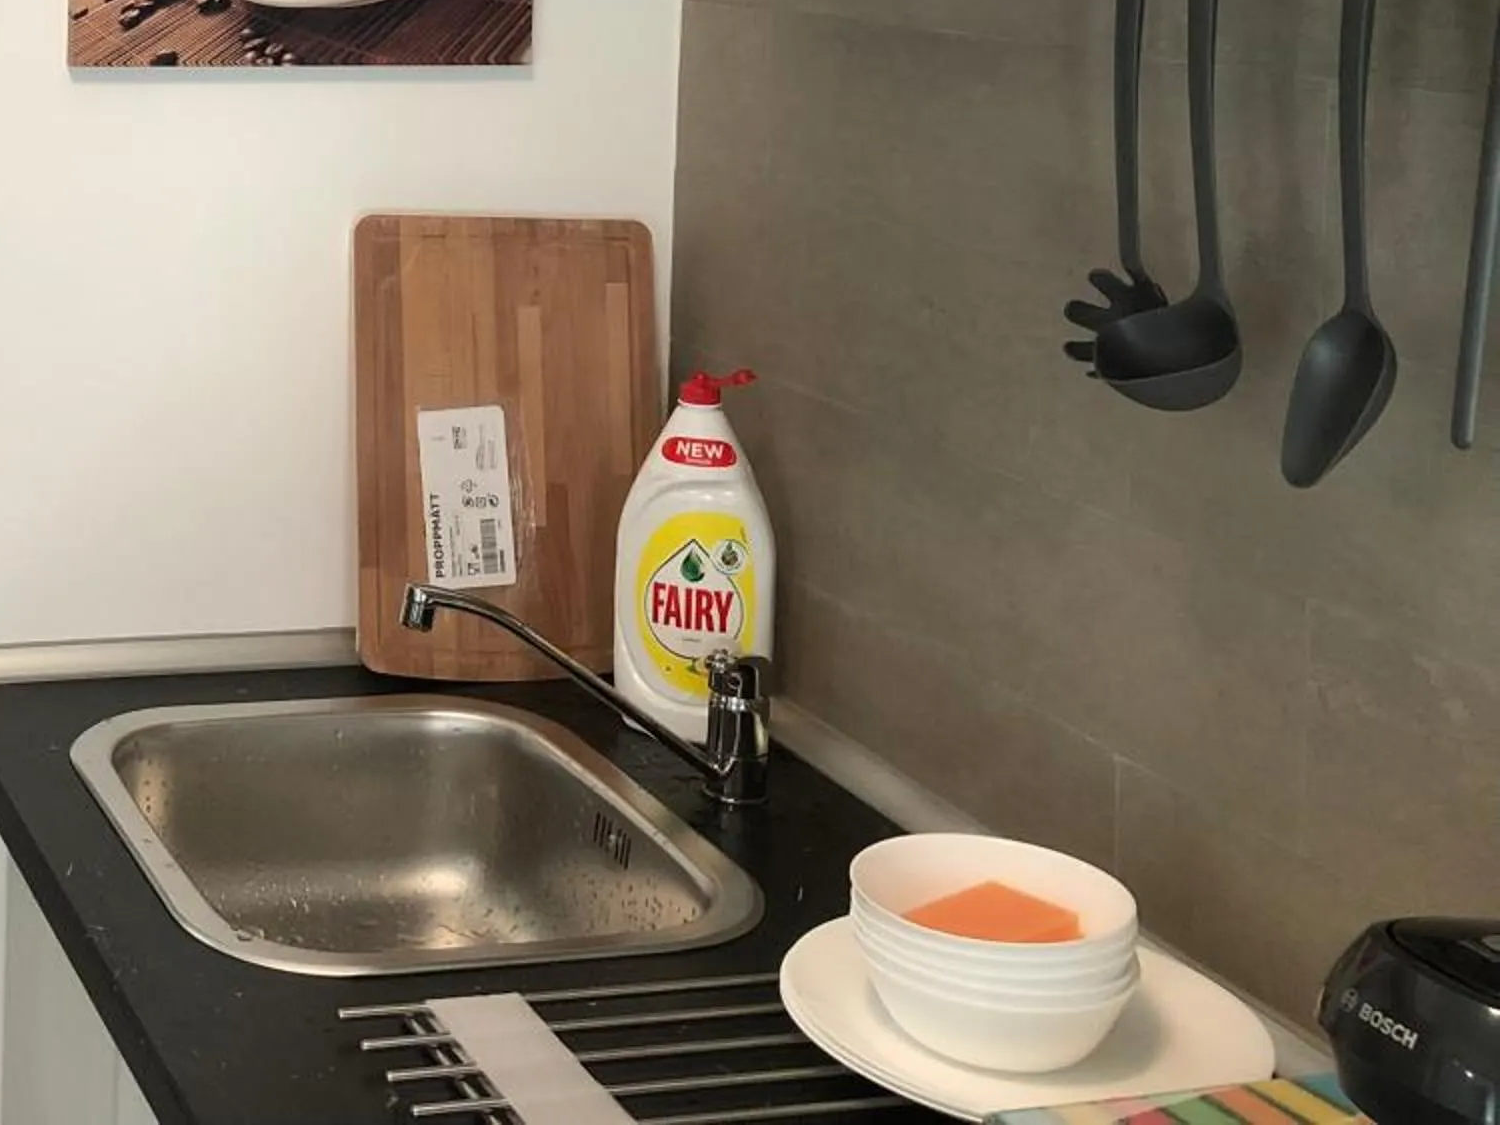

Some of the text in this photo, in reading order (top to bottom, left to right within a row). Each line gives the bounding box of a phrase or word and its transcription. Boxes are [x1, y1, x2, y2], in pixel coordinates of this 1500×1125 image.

[675, 440, 724, 460] NEW
[652, 581, 735, 634] FAIRY
[1358, 1003, 1419, 1050] BOSCH
